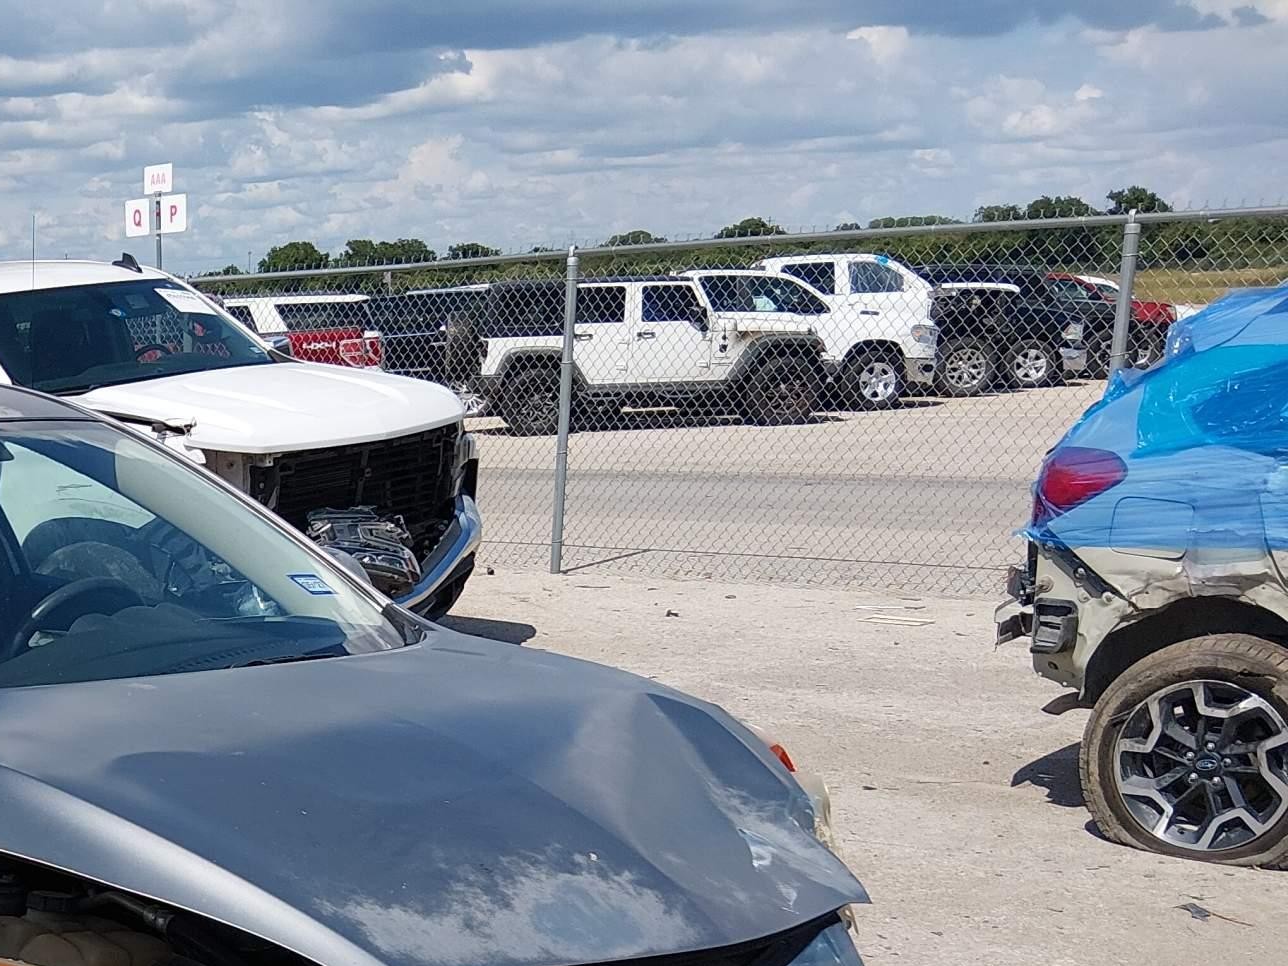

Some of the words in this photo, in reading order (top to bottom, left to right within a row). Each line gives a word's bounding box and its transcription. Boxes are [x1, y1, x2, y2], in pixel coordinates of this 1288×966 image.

[151, 172, 166, 186] AAA
[133, 208, 142, 228] Q
[170, 205, 178, 224] P
